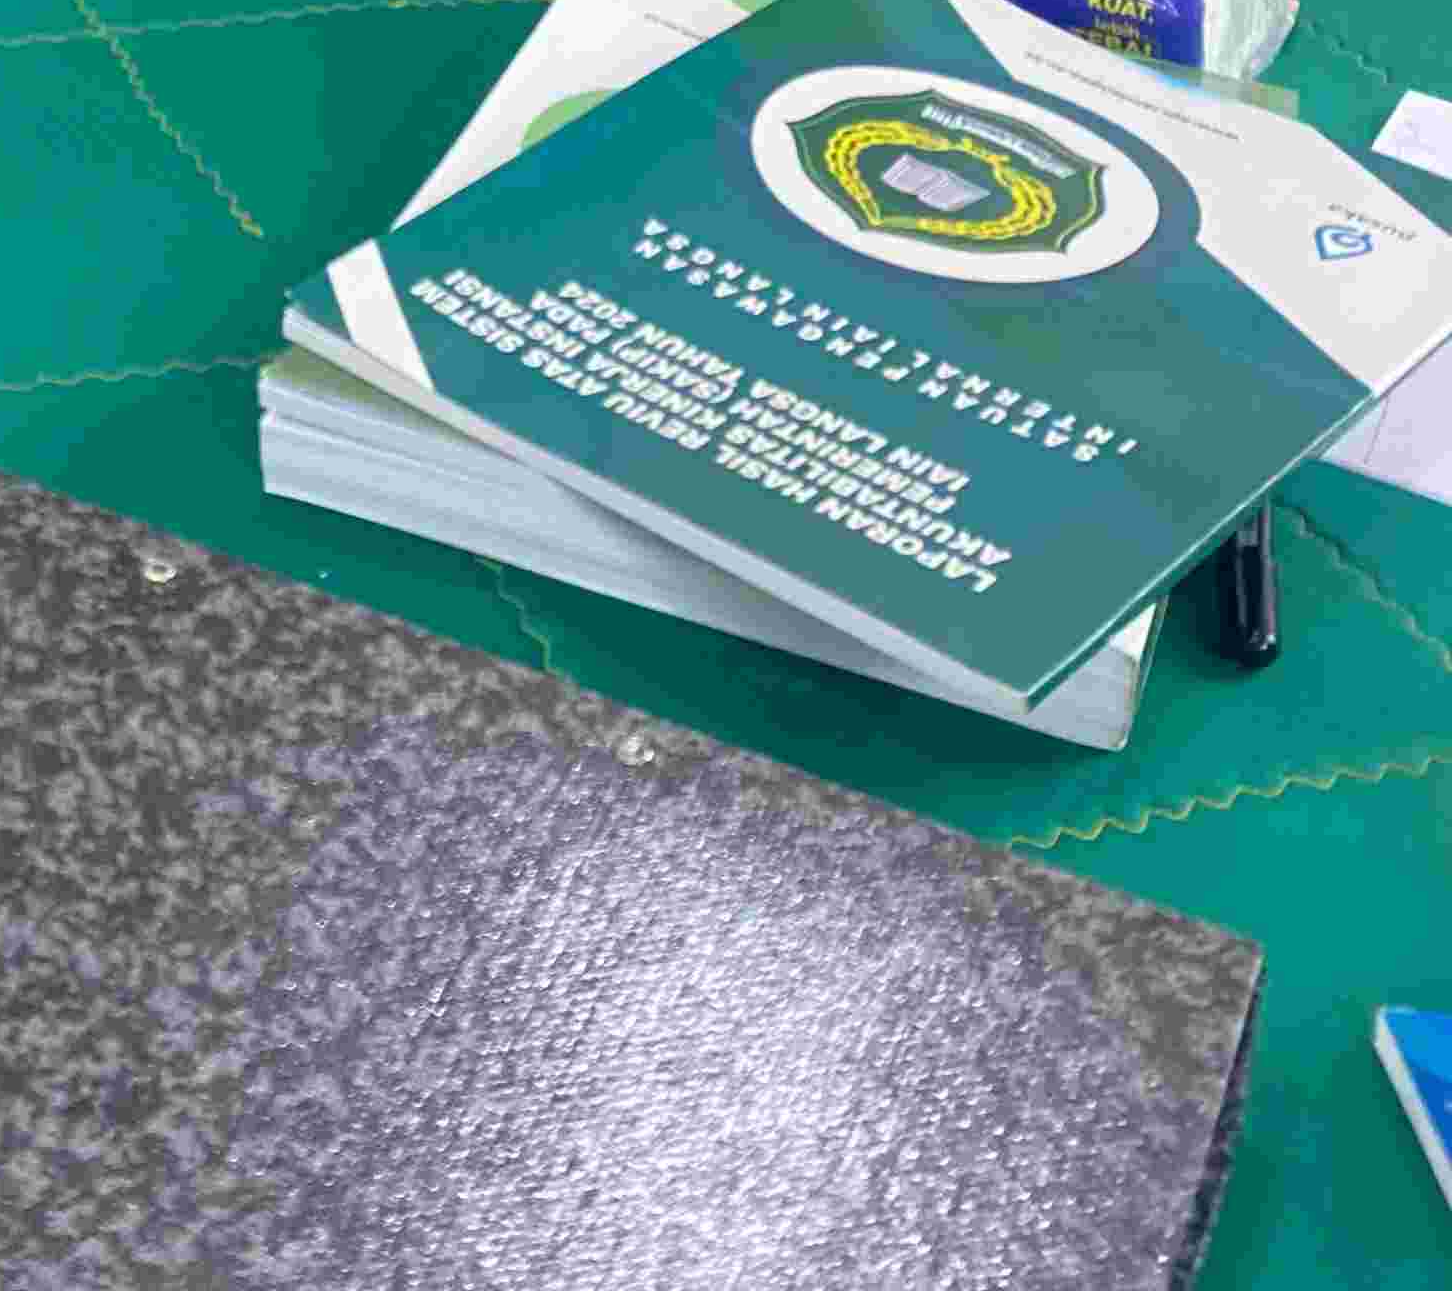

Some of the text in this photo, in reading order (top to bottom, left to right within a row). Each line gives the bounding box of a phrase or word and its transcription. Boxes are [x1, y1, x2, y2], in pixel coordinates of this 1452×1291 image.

[409, 277, 997, 593] LAPORAN HASIL REVIU ATAS SISTEM
[443, 268, 1013, 566] AKUNTABILITAS KINERJA INSTANSI
[529, 289, 957, 514] PEMERINTAH (SAKIP) PADA
[557, 279, 971, 493] IAIN LANGSA TAHUN 2024
[631, 238, 1100, 464] SATUAN PENGAWASAN
[642, 215, 1140, 456] INTERNAL IAIN LANGSA
